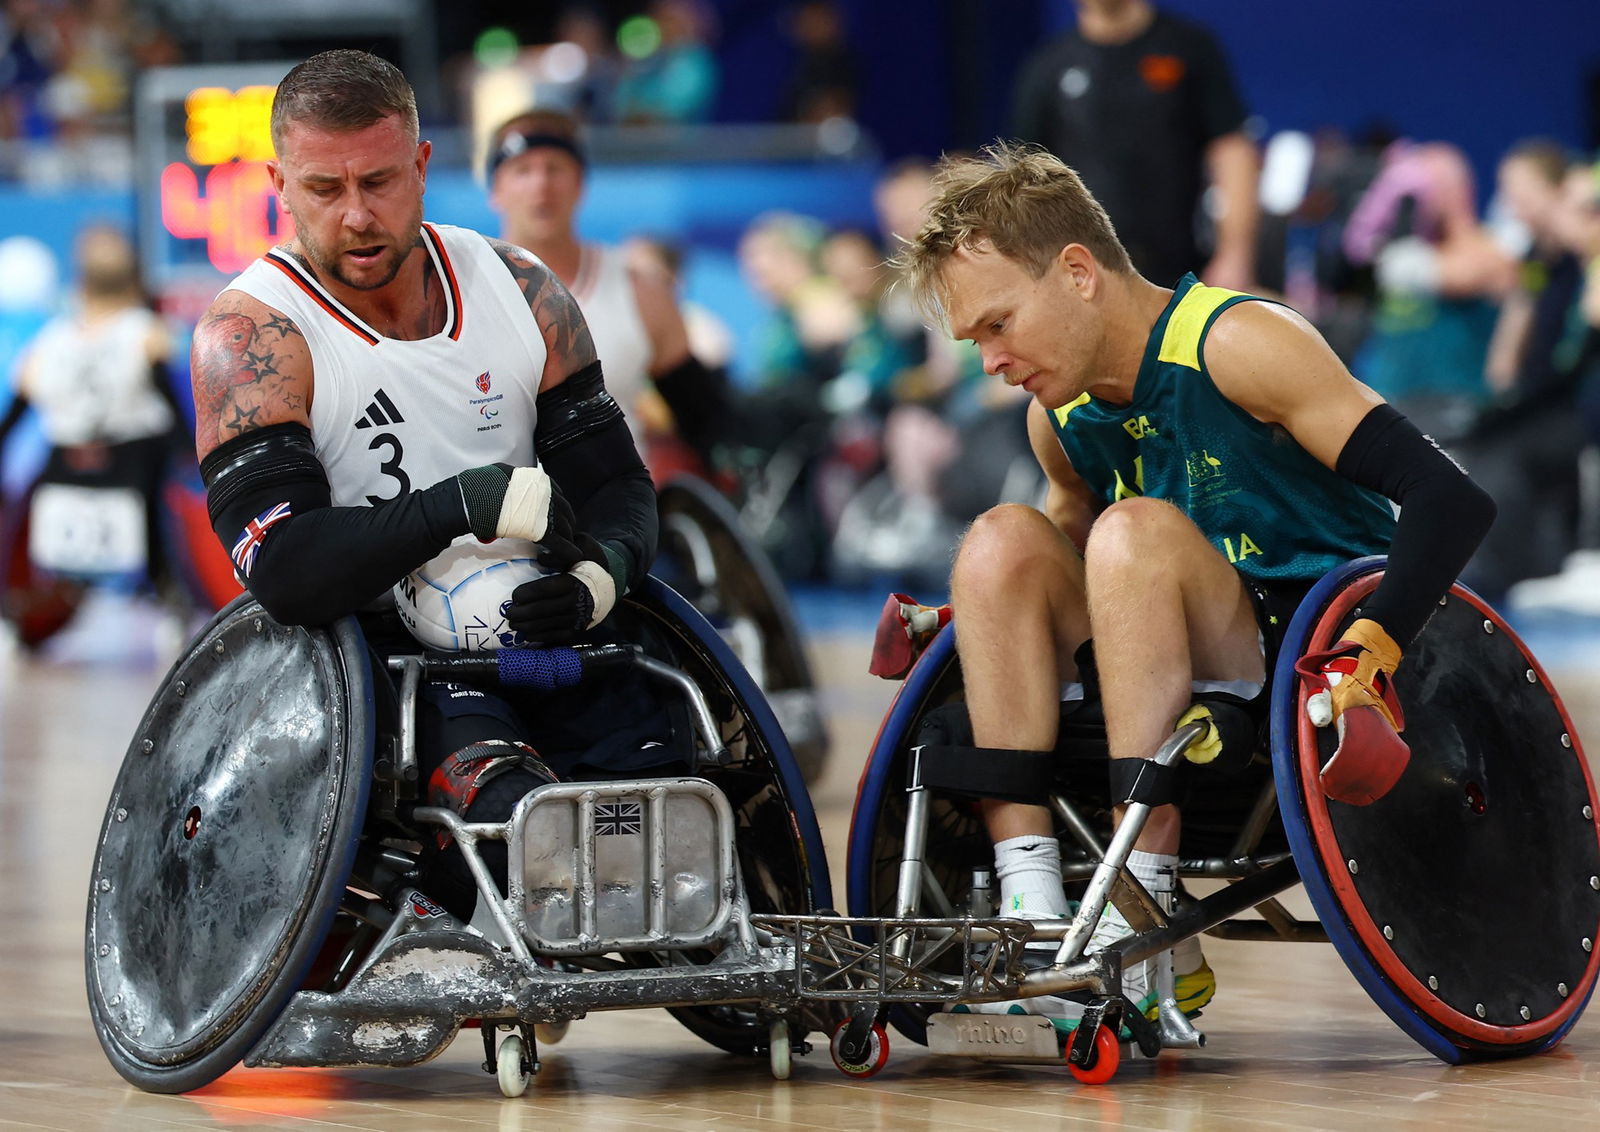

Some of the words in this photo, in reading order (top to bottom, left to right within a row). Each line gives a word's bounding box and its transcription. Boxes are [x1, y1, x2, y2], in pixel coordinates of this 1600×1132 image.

[365, 433, 410, 507] 3
[450, 690, 468, 699] PARIS
[468, 690, 485, 698] 2024
[955, 1019, 1027, 1045] rhino
